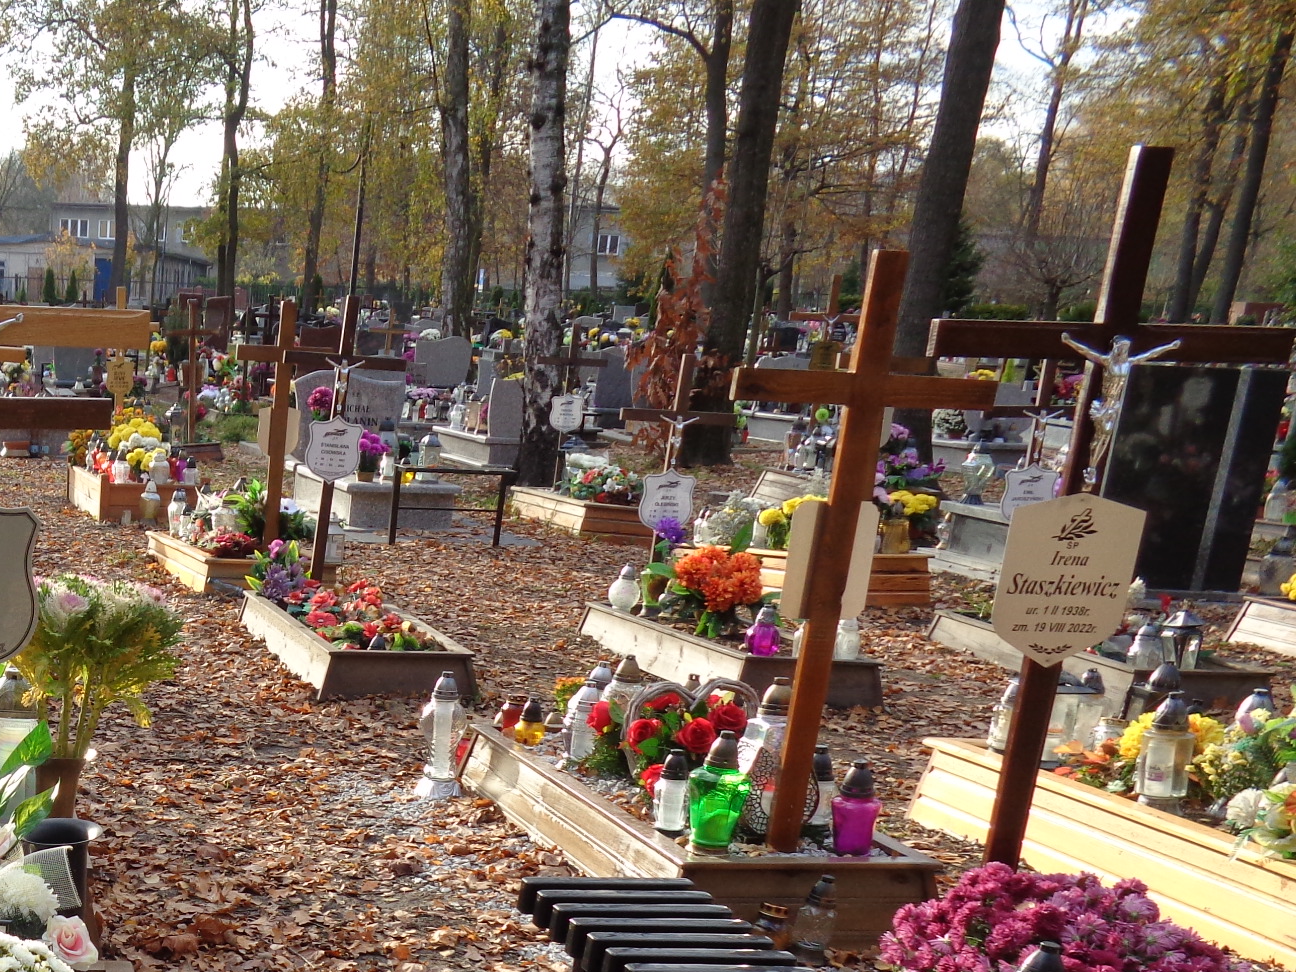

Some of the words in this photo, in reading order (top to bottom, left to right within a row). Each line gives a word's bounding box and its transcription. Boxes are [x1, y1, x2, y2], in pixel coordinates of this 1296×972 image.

[1050, 550, 1090, 567] Irena
[1006, 572, 1121, 600] Staszkiewicz
[1011, 623, 1029, 633] zm.
[1034, 622, 1046, 632] 19
